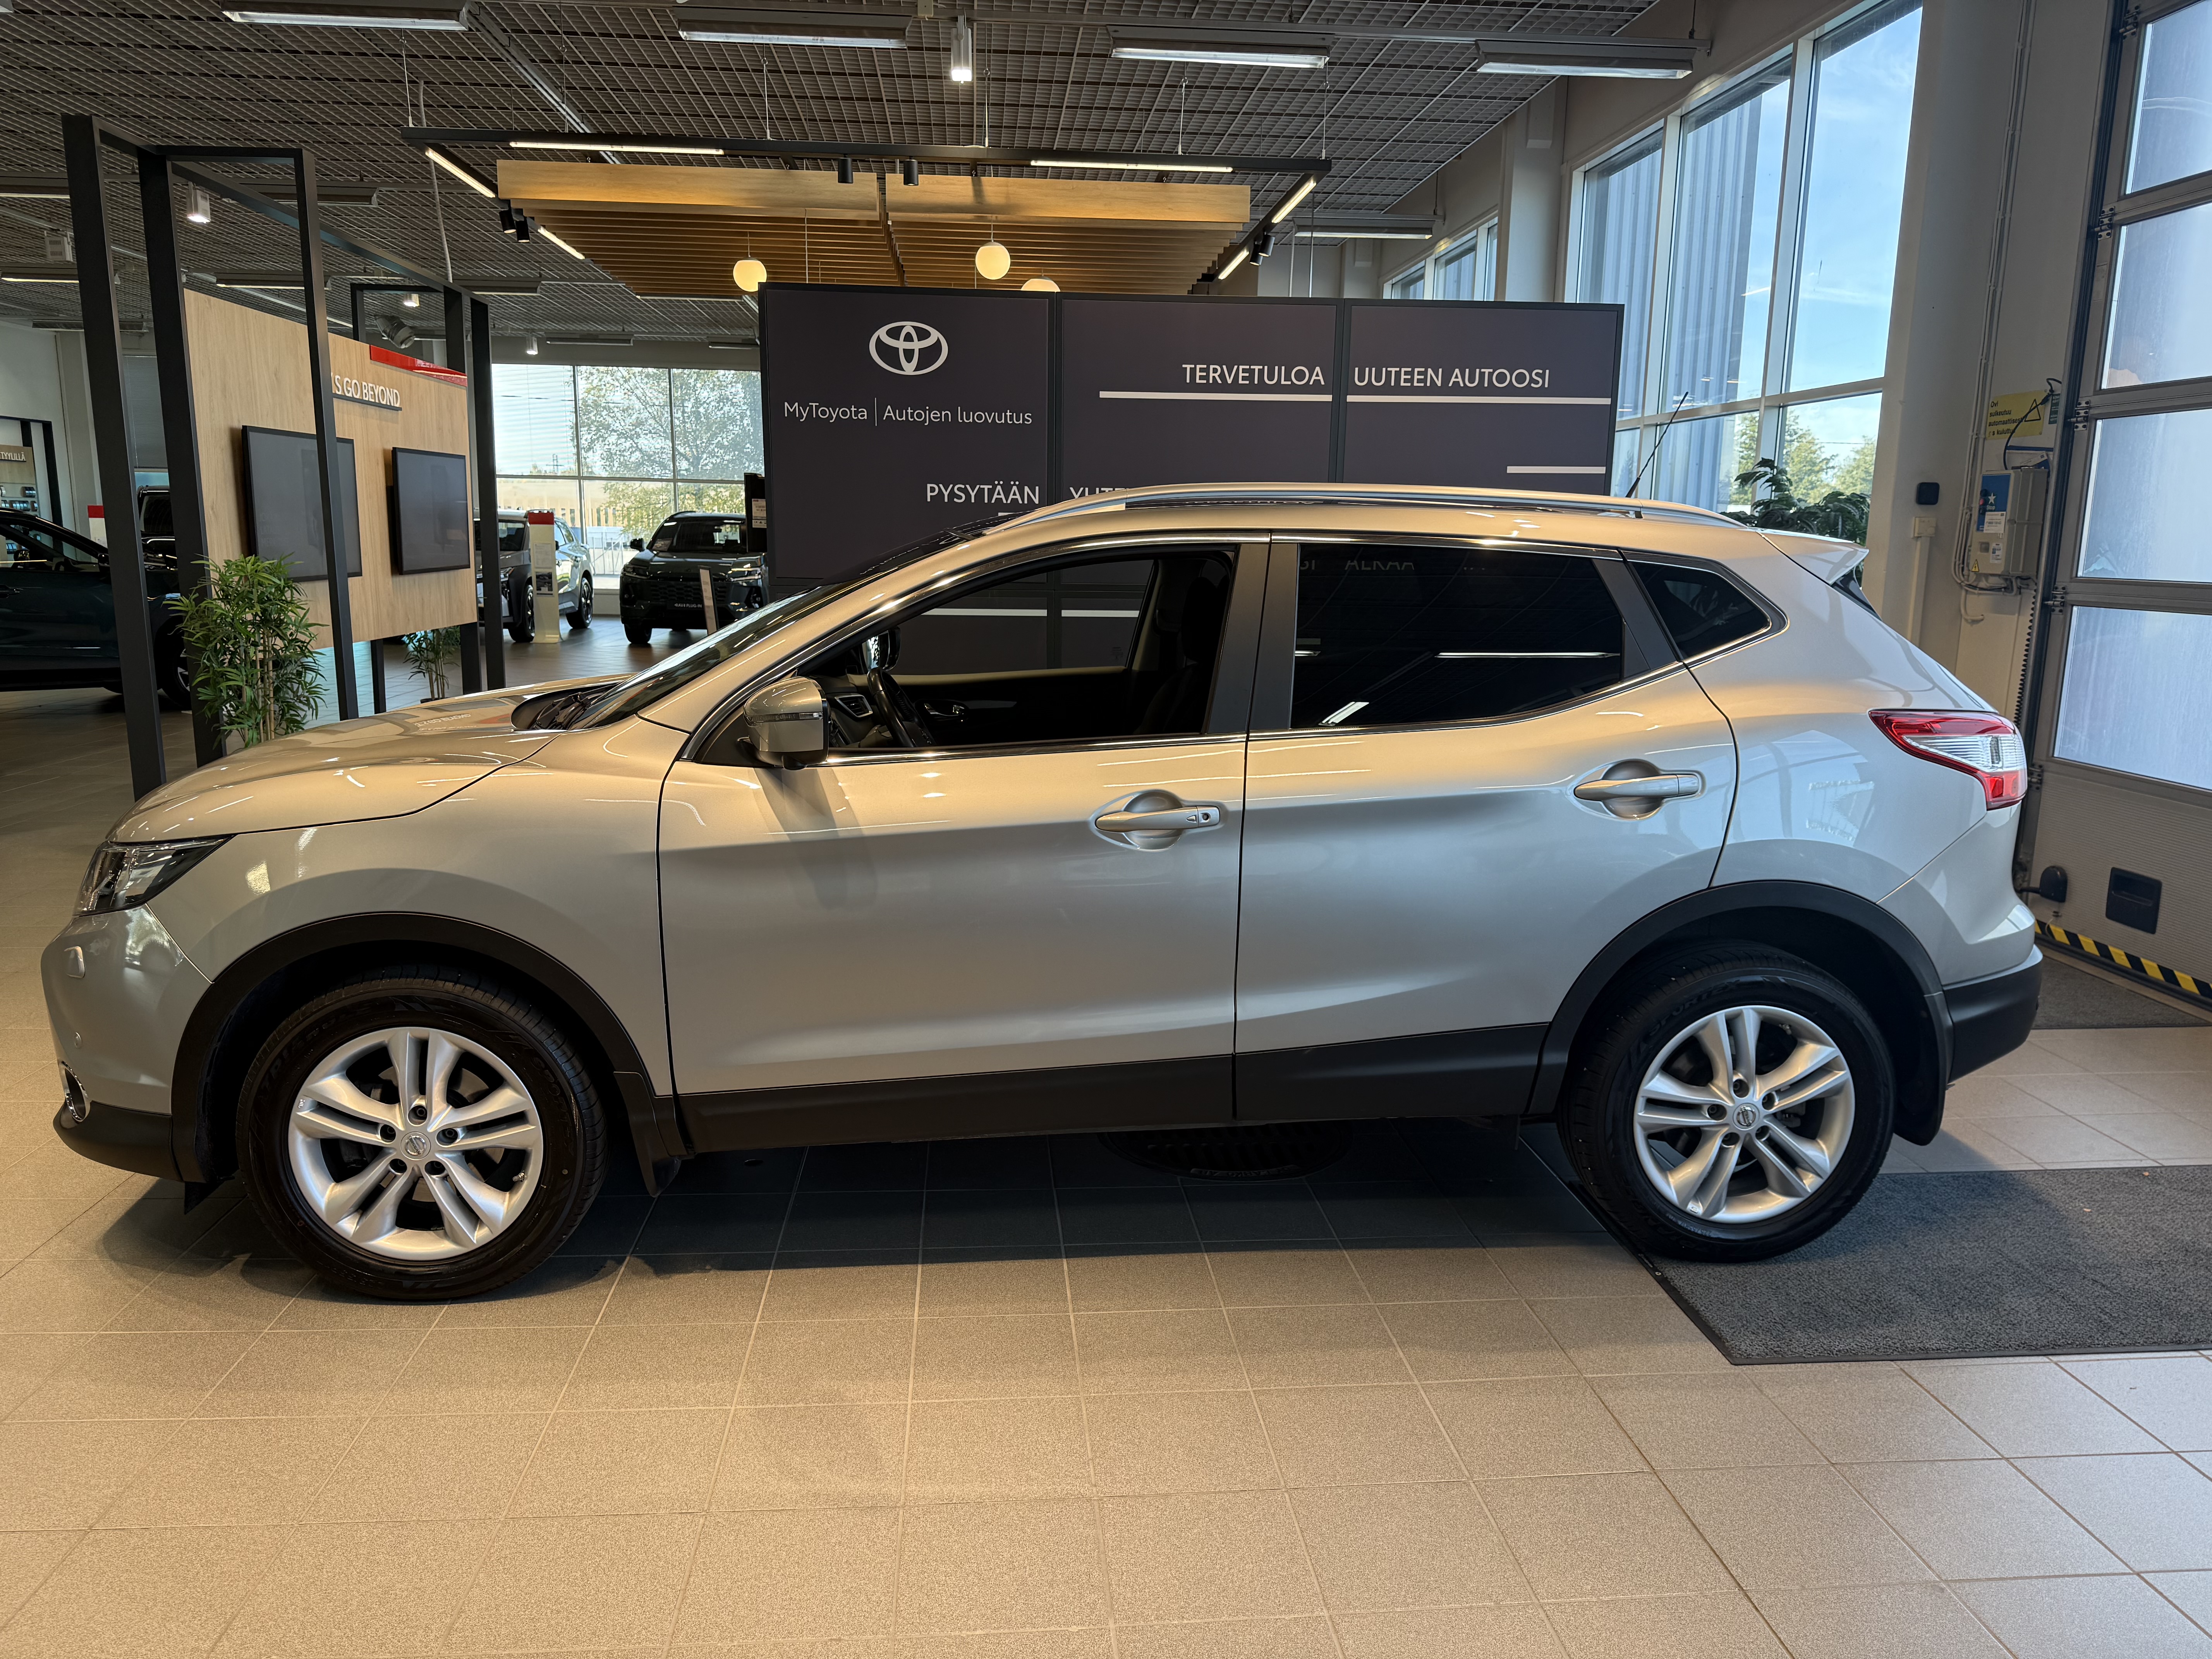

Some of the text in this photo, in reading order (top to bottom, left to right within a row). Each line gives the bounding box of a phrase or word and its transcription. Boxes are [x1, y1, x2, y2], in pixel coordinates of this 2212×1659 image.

[1182, 364, 1549, 388] TERVETULOA UUTEEN AUTOOSI
[343, 378, 360, 398] GO
[362, 381, 400, 407] BEYOND
[785, 402, 1032, 425] MyToyota Autojen luovutus
[927, 481, 1039, 504] PYSYTÄÄN
